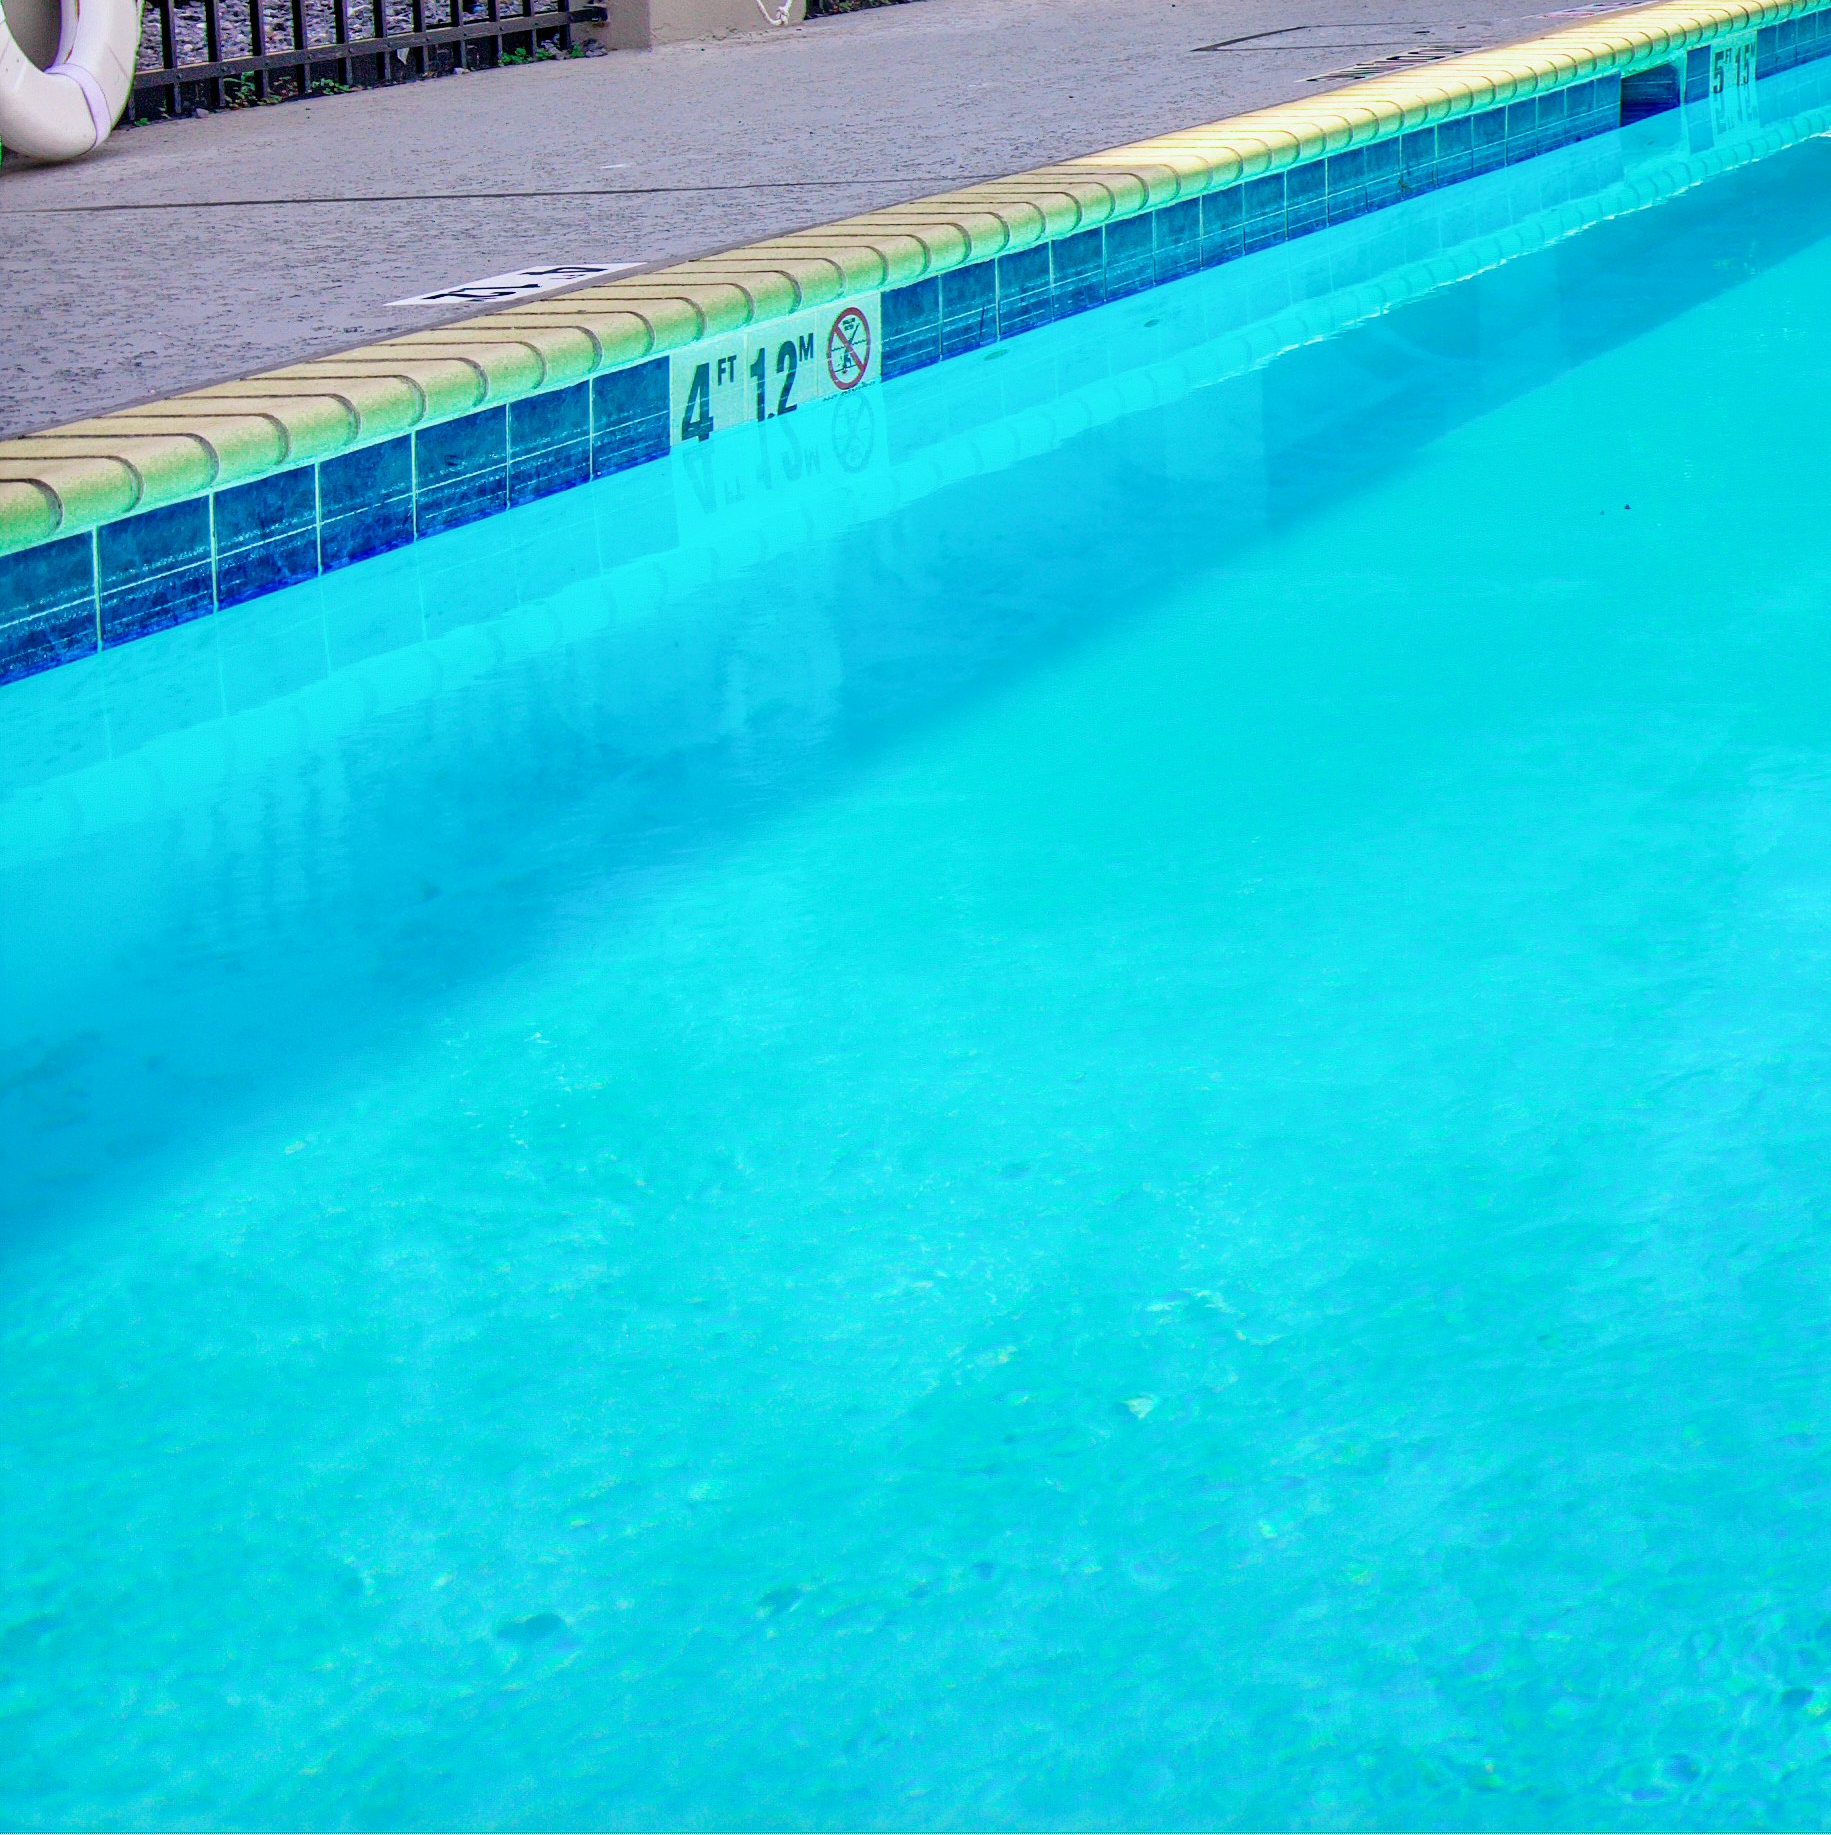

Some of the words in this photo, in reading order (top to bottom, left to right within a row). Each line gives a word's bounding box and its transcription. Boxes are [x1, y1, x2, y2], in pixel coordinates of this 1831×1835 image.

[681, 362, 714, 442] 4
[717, 355, 737, 387] FT
[750, 339, 798, 422] 1.2
[799, 332, 814, 363] M
